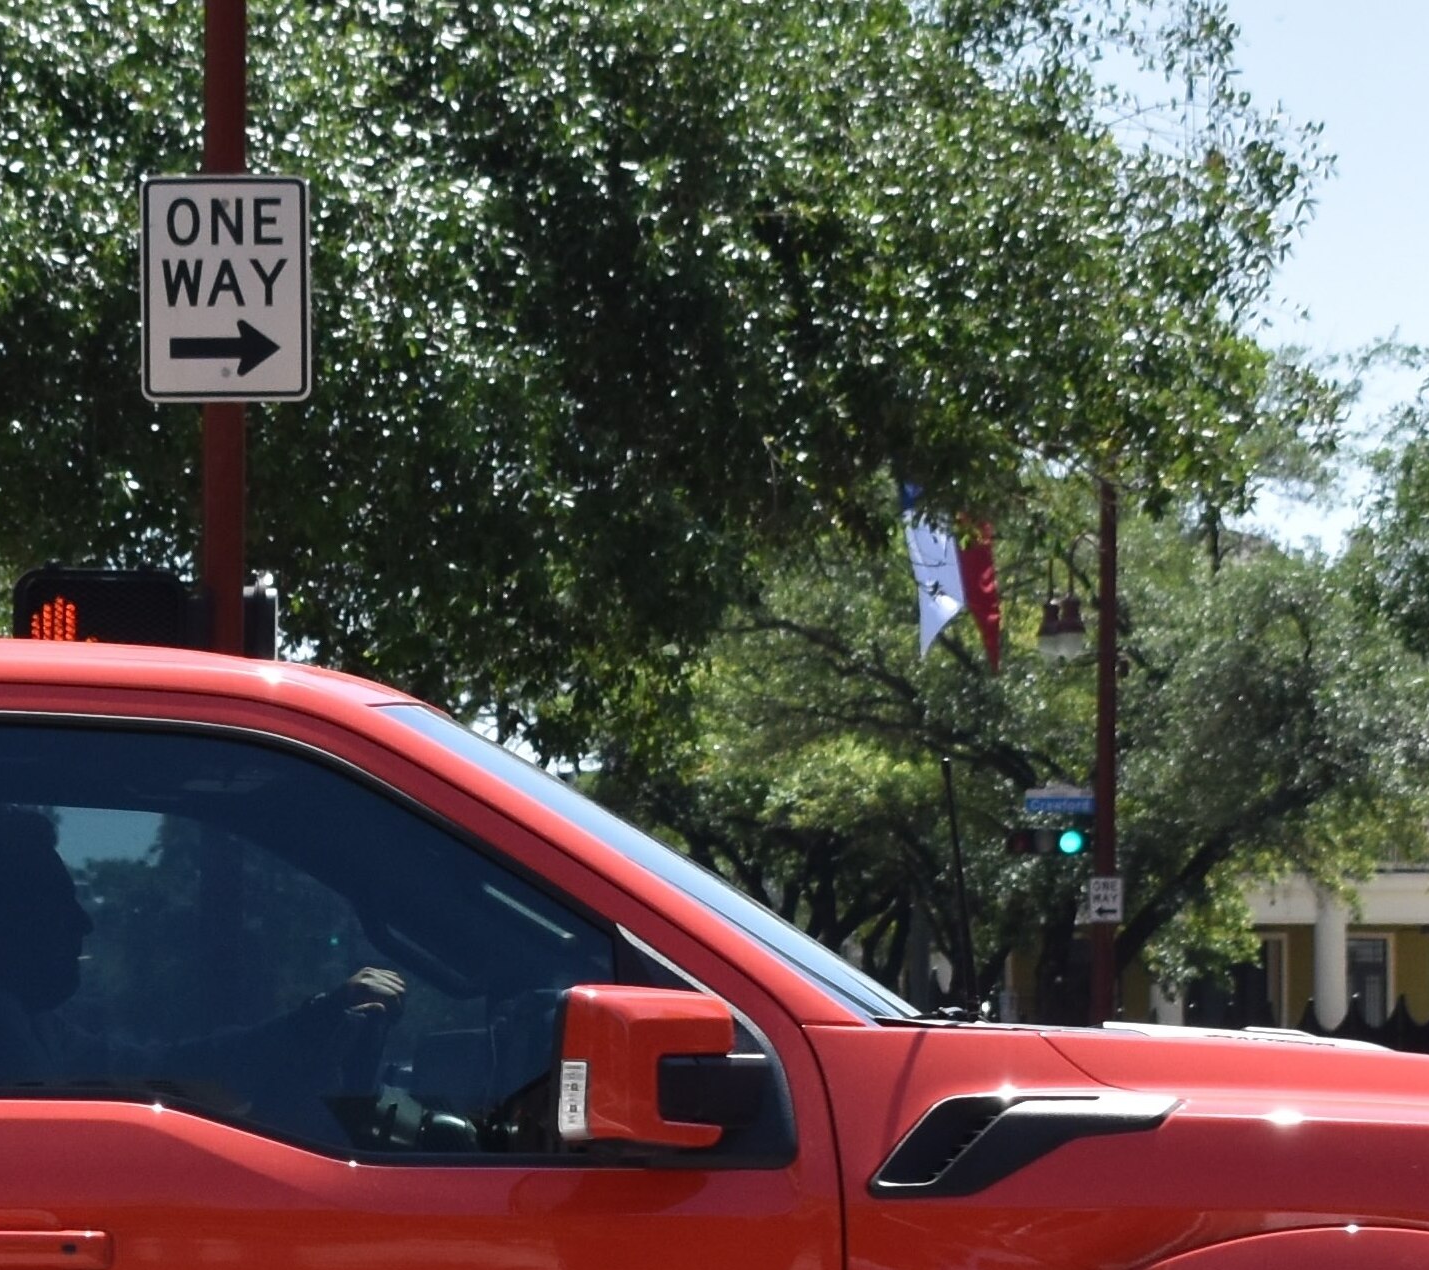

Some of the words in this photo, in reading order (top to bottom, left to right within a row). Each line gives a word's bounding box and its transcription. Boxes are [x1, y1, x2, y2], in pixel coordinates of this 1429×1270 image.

[166, 197, 283, 246] ONE
[162, 258, 288, 307] WAY
[1093, 881, 1118, 892] ONE
[1093, 893, 1119, 903] WAY
